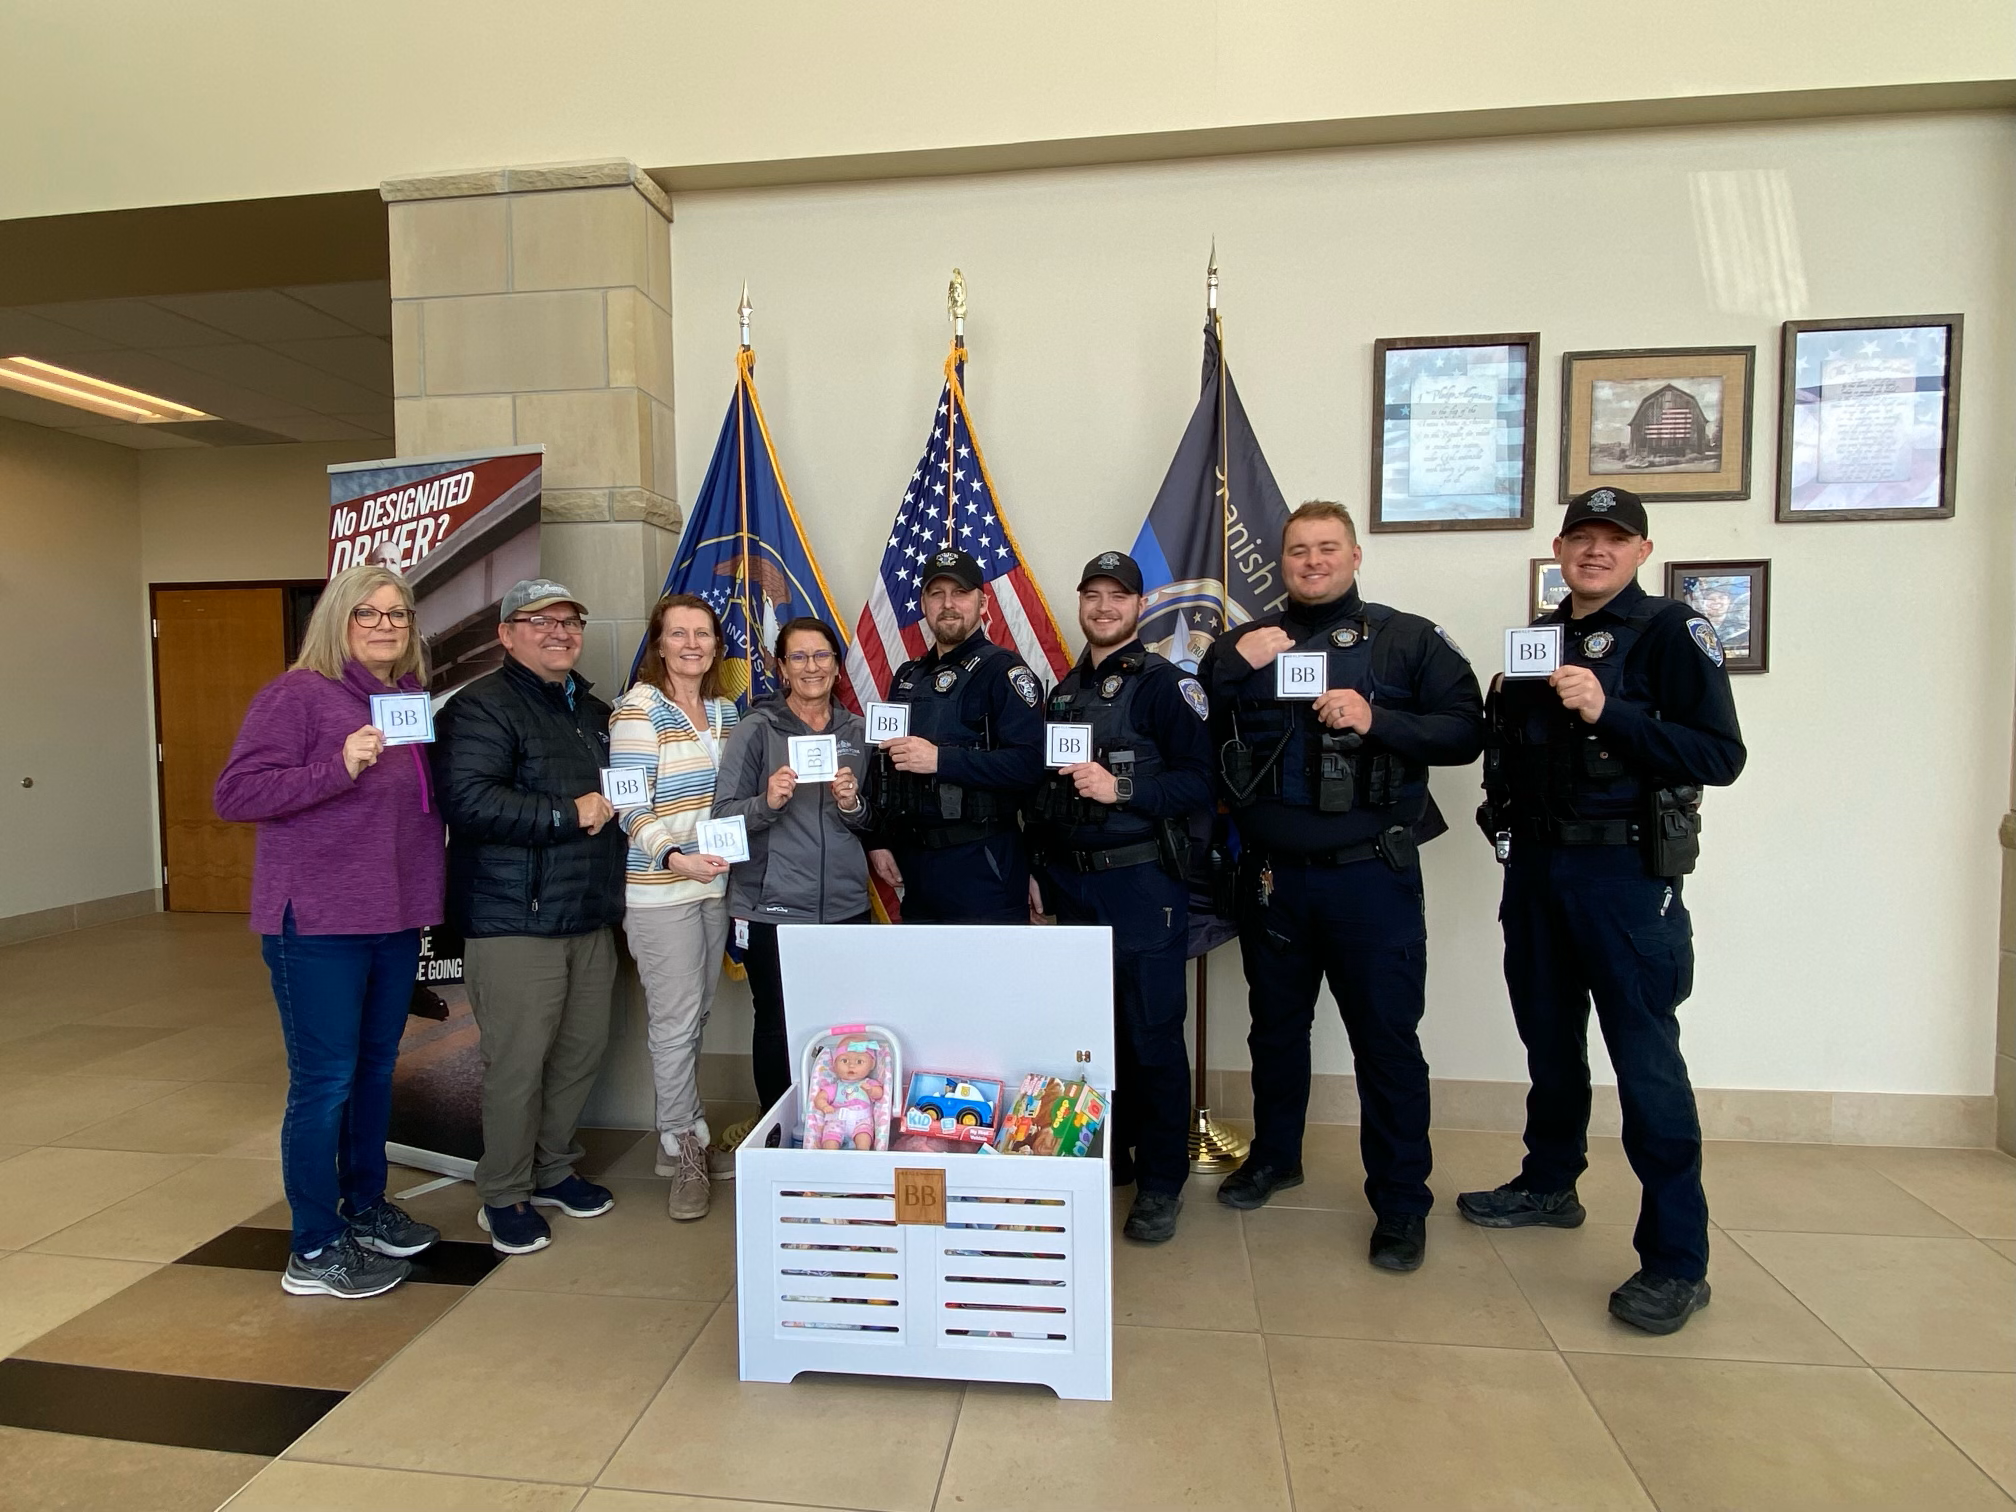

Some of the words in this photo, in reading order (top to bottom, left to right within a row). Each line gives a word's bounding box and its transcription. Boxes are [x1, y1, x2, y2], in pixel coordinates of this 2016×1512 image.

[359, 471, 475, 533] DESIGNATED
[1520, 643, 1547, 660] BB
[1291, 667, 1316, 683] BB
[391, 709, 418, 727] BB
[878, 716, 899, 732] BB
[1058, 737, 1081, 754] BB
[807, 747, 822, 768] BB
[616, 779, 639, 795] BB
[713, 832, 736, 848] BB
[428, 958, 462, 980] GOING
[909, 1113, 931, 1126] KID
[904, 1184, 937, 1207] BB
